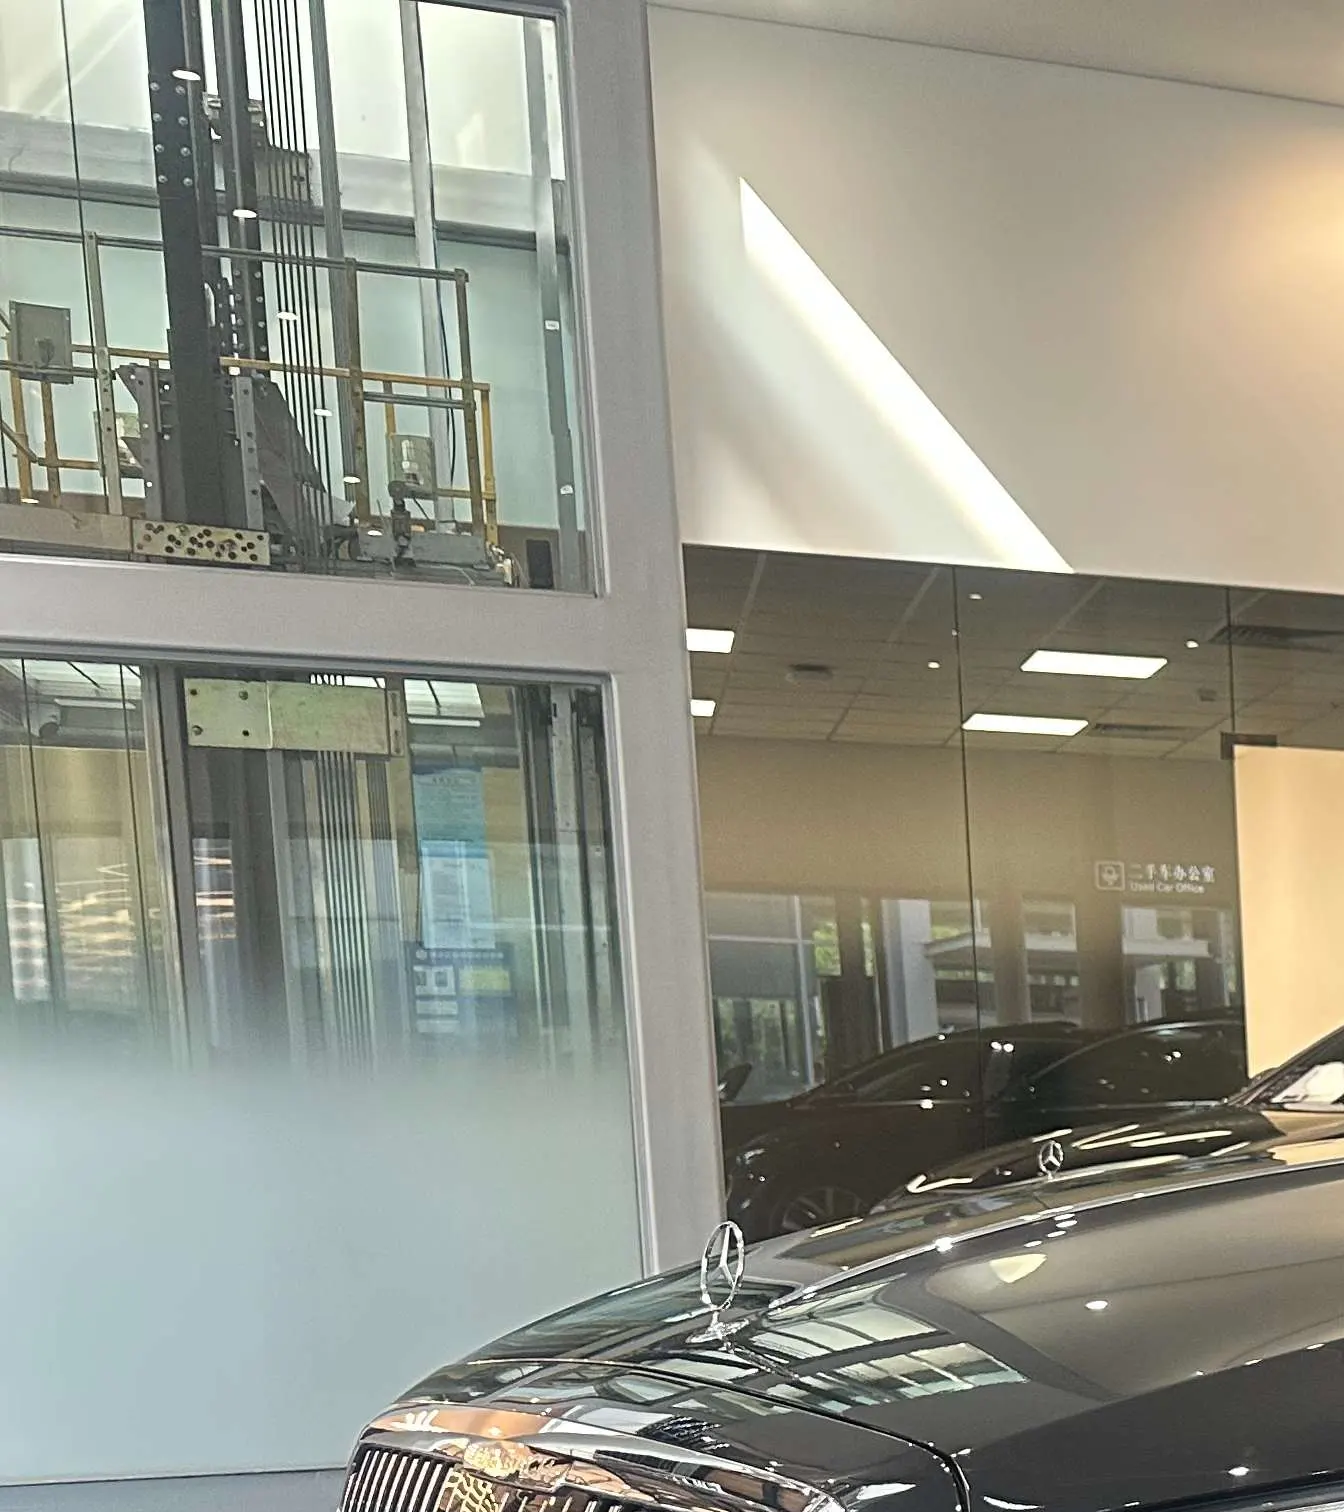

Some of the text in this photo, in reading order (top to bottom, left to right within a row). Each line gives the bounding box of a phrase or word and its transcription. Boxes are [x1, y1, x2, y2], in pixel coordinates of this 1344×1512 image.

[1129, 863, 1216, 883] 二手车办公室
